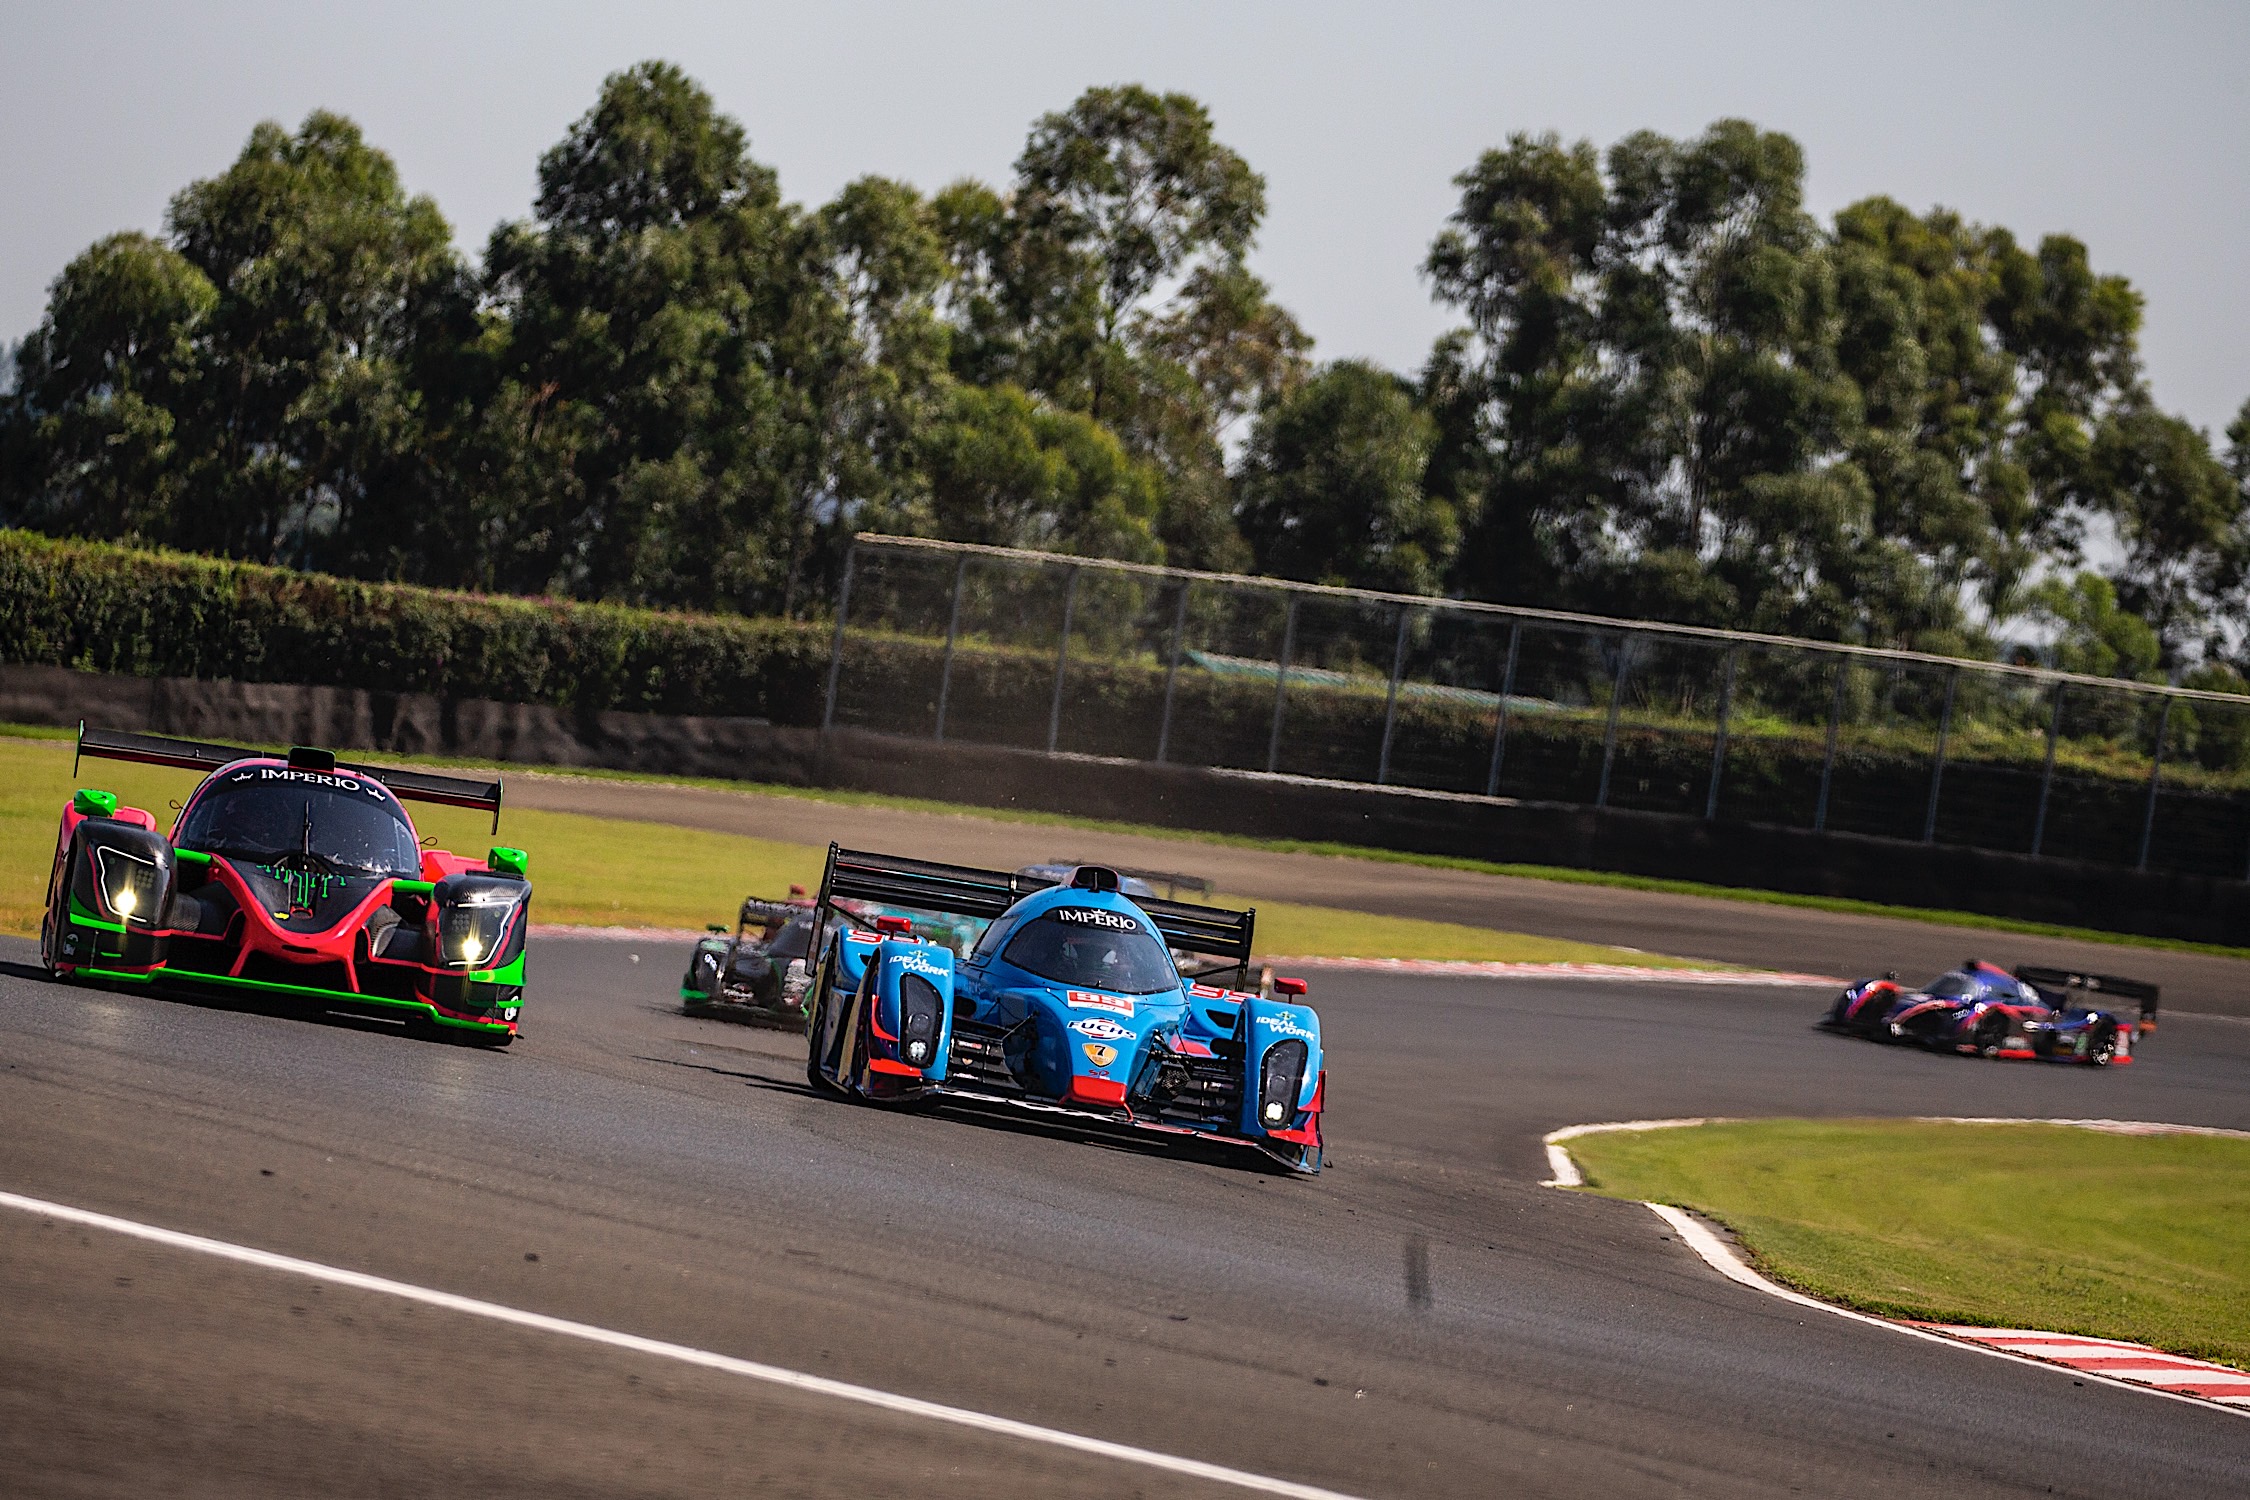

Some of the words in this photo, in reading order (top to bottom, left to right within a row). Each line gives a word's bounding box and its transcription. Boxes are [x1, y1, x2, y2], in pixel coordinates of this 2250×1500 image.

[902, 961, 950, 977] WORK
[1068, 1021, 1136, 1039] FUCHS
[1256, 1016, 1298, 1029] IDEAL
[1269, 1023, 1316, 1041] WORK
[1094, 1045, 1107, 1057] 7
